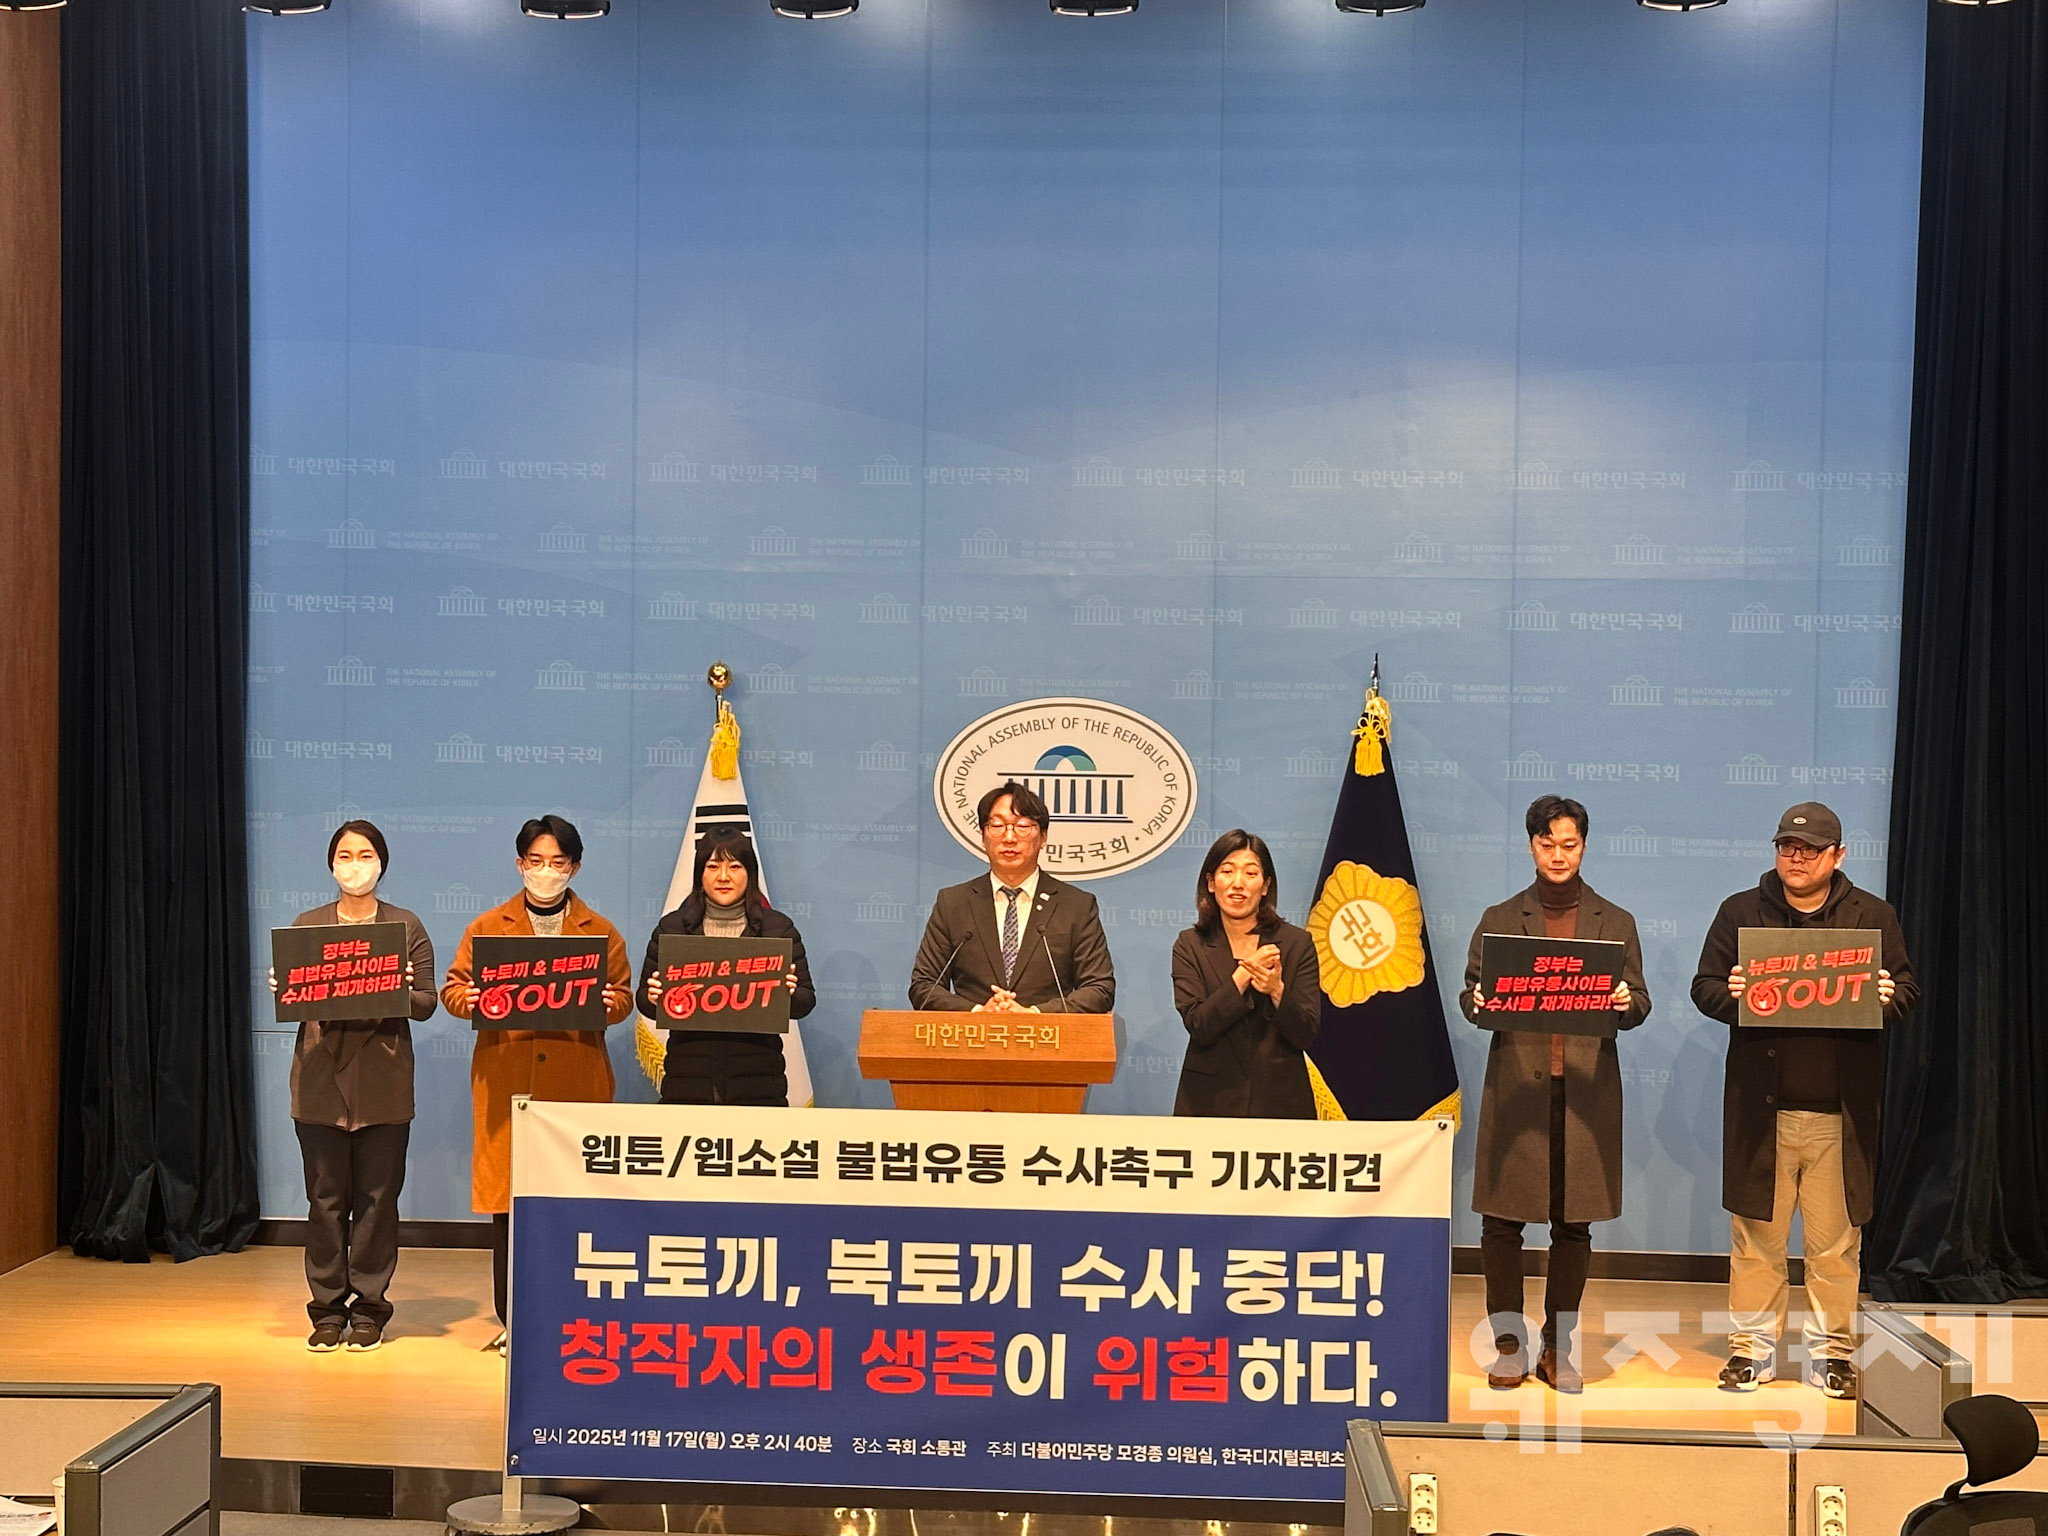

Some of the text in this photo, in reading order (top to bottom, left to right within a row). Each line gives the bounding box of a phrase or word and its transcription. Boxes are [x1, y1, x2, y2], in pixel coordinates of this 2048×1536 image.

[288, 457, 395, 477] 대한민국국회
[499, 460, 606, 480] 대한민국국회
[710, 464, 817, 484] 대한민국국회
[921, 466, 1029, 486] 대한민국국회
[1136, 467, 1245, 487] 대한민국국회
[1352, 469, 1464, 489] 대한민국국회
[1573, 471, 1686, 490] 대한민국국회
[287, 594, 394, 613] 대한민국국회
[498, 598, 604, 617] 대한민국국회
[709, 601, 816, 621] 대한민국국회
[921, 604, 1028, 623] 대한민국국회
[1134, 607, 1243, 626] 대한민국국회
[1350, 609, 1461, 629] 대한민국국회
[1570, 611, 1683, 631] 대한민국국회
[988, 717, 1056, 749] ASSEMBLY
[1061, 717, 1079, 729] OF
[1084, 718, 1110, 735] THE
[285, 741, 392, 760] 대한민국국회
[496, 744, 602, 764] 대한민국국회
[1113, 726, 1170, 771] REPUBLIC
[743, 749, 813, 769] 민국국회
[953, 745, 988, 809] NATIONAL
[1163, 772, 1178, 792] OF
[1567, 763, 1680, 783] 대한민국국회
[1791, 766, 1893, 785] 대한민국국
[1142, 796, 1177, 836] KOREA
[1046, 835, 1130, 864] 민국국회
[1341, 903, 1390, 967] 국회
[322, 939, 371, 961] 정부는
[288, 954, 400, 985] 불법유통사이트
[481, 953, 600, 982] 뉴토끼 & 북토끼
[665, 955, 784, 981] 뉴토끼 & 북토끼
[1533, 955, 1584, 973] 정부는
[1747, 947, 1874, 976] 뉴토끼 & 북토끼
[280, 974, 402, 1005] 수사를 재개하라!
[1495, 975, 1612, 992] 불법유통사이트
[1786, 973, 1871, 1009] OUT
[516, 978, 597, 1013] OUT
[701, 980, 781, 1013] OUT
[1485, 995, 1613, 1012] 수사를 재개하라!
[914, 1023, 1060, 1049] 대한민국국회
[582, 1135, 1382, 1193] 웹툰/웹소설 불법유통 수사촉구 기자회견
[574, 1232, 1385, 1317] 뉴토끼, 북토끼 수사 중단!
[560, 1319, 1397, 1408] 창작자의 생존이 위험하다.
[532, 1428, 1346, 1469] 일시 2025년 11월 17일(월) 오후 2시 40분 장소 국회 소통관 주최 더불어민주당 모경종 의원실, 한국디지털콘텐츠
